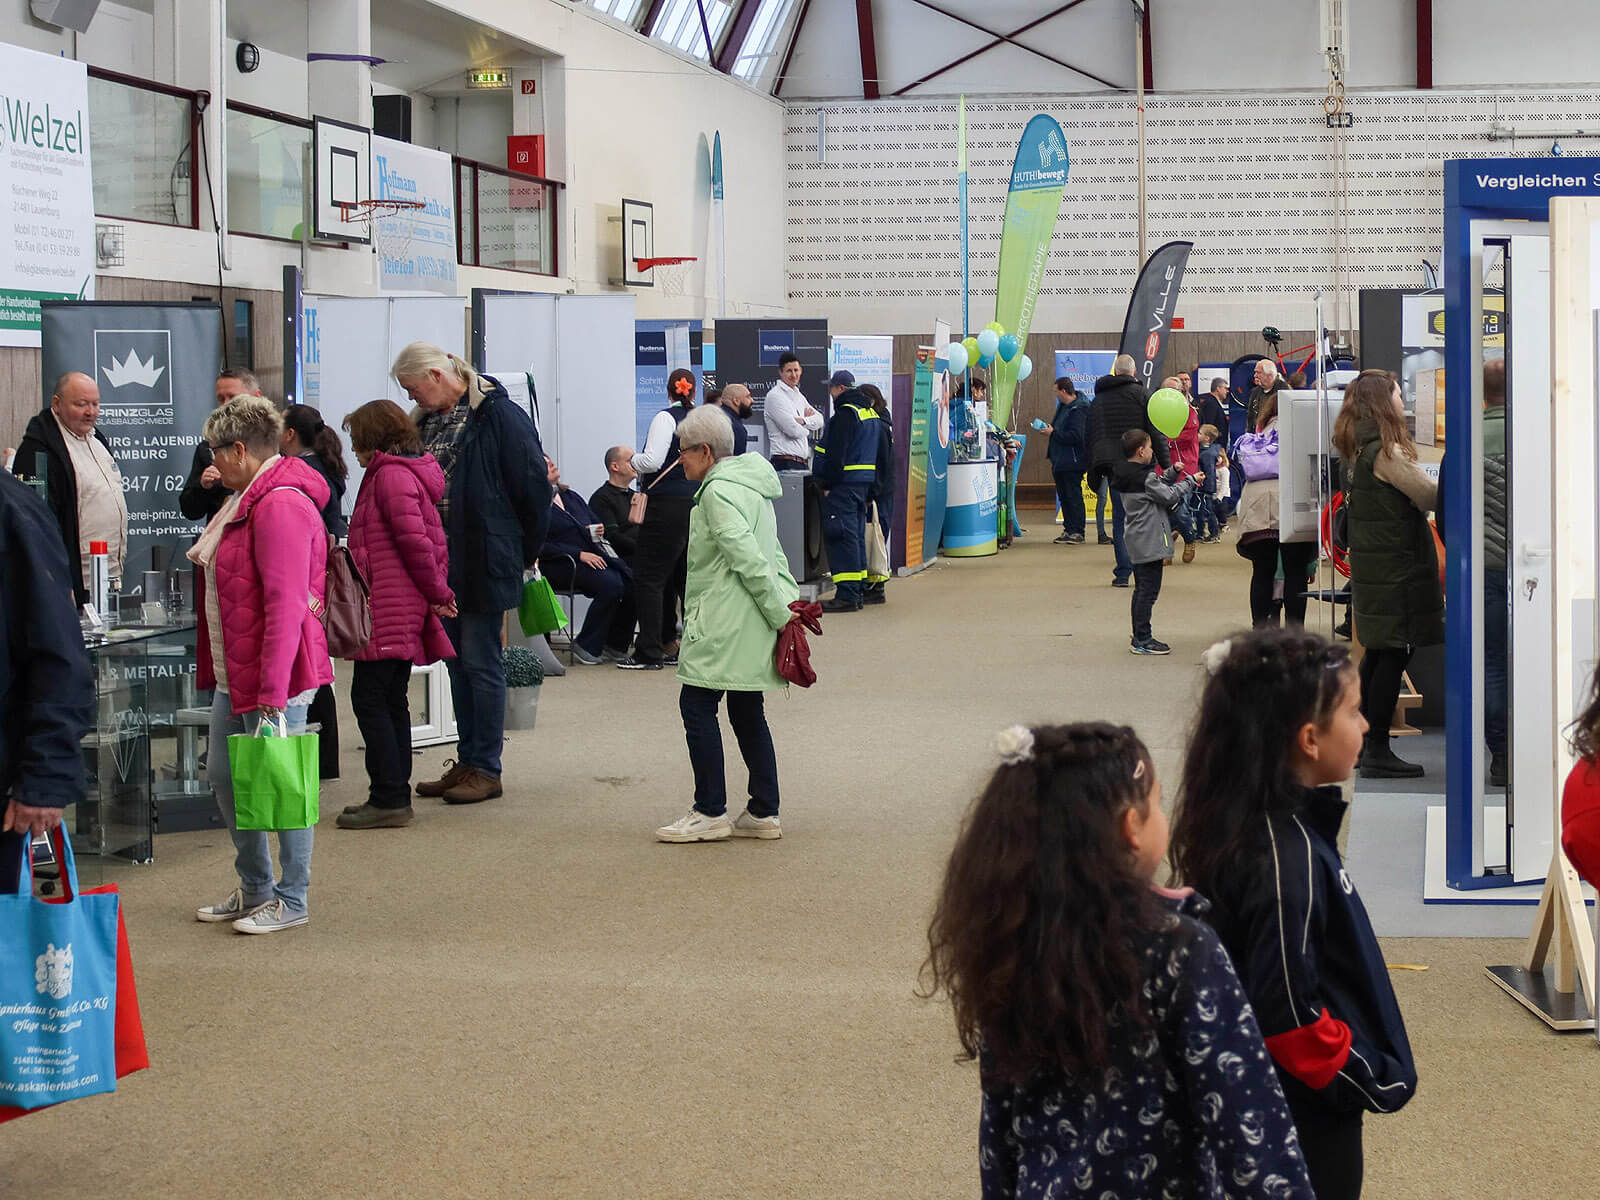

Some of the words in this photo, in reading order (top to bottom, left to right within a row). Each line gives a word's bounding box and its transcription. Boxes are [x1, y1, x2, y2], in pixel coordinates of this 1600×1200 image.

[6, 97, 83, 155] Welzel
[1475, 173, 1587, 191] Vergleichen
[1017, 241, 1048, 348] ERGOTHERAPIE
[1149, 264, 1177, 332] VILLE
[639, 376, 664, 385] Schritt
[113, 448, 168, 460] AMBURG
[126, 524, 206, 537] erei-prinz.de
[93, 996, 109, 1010] KG
